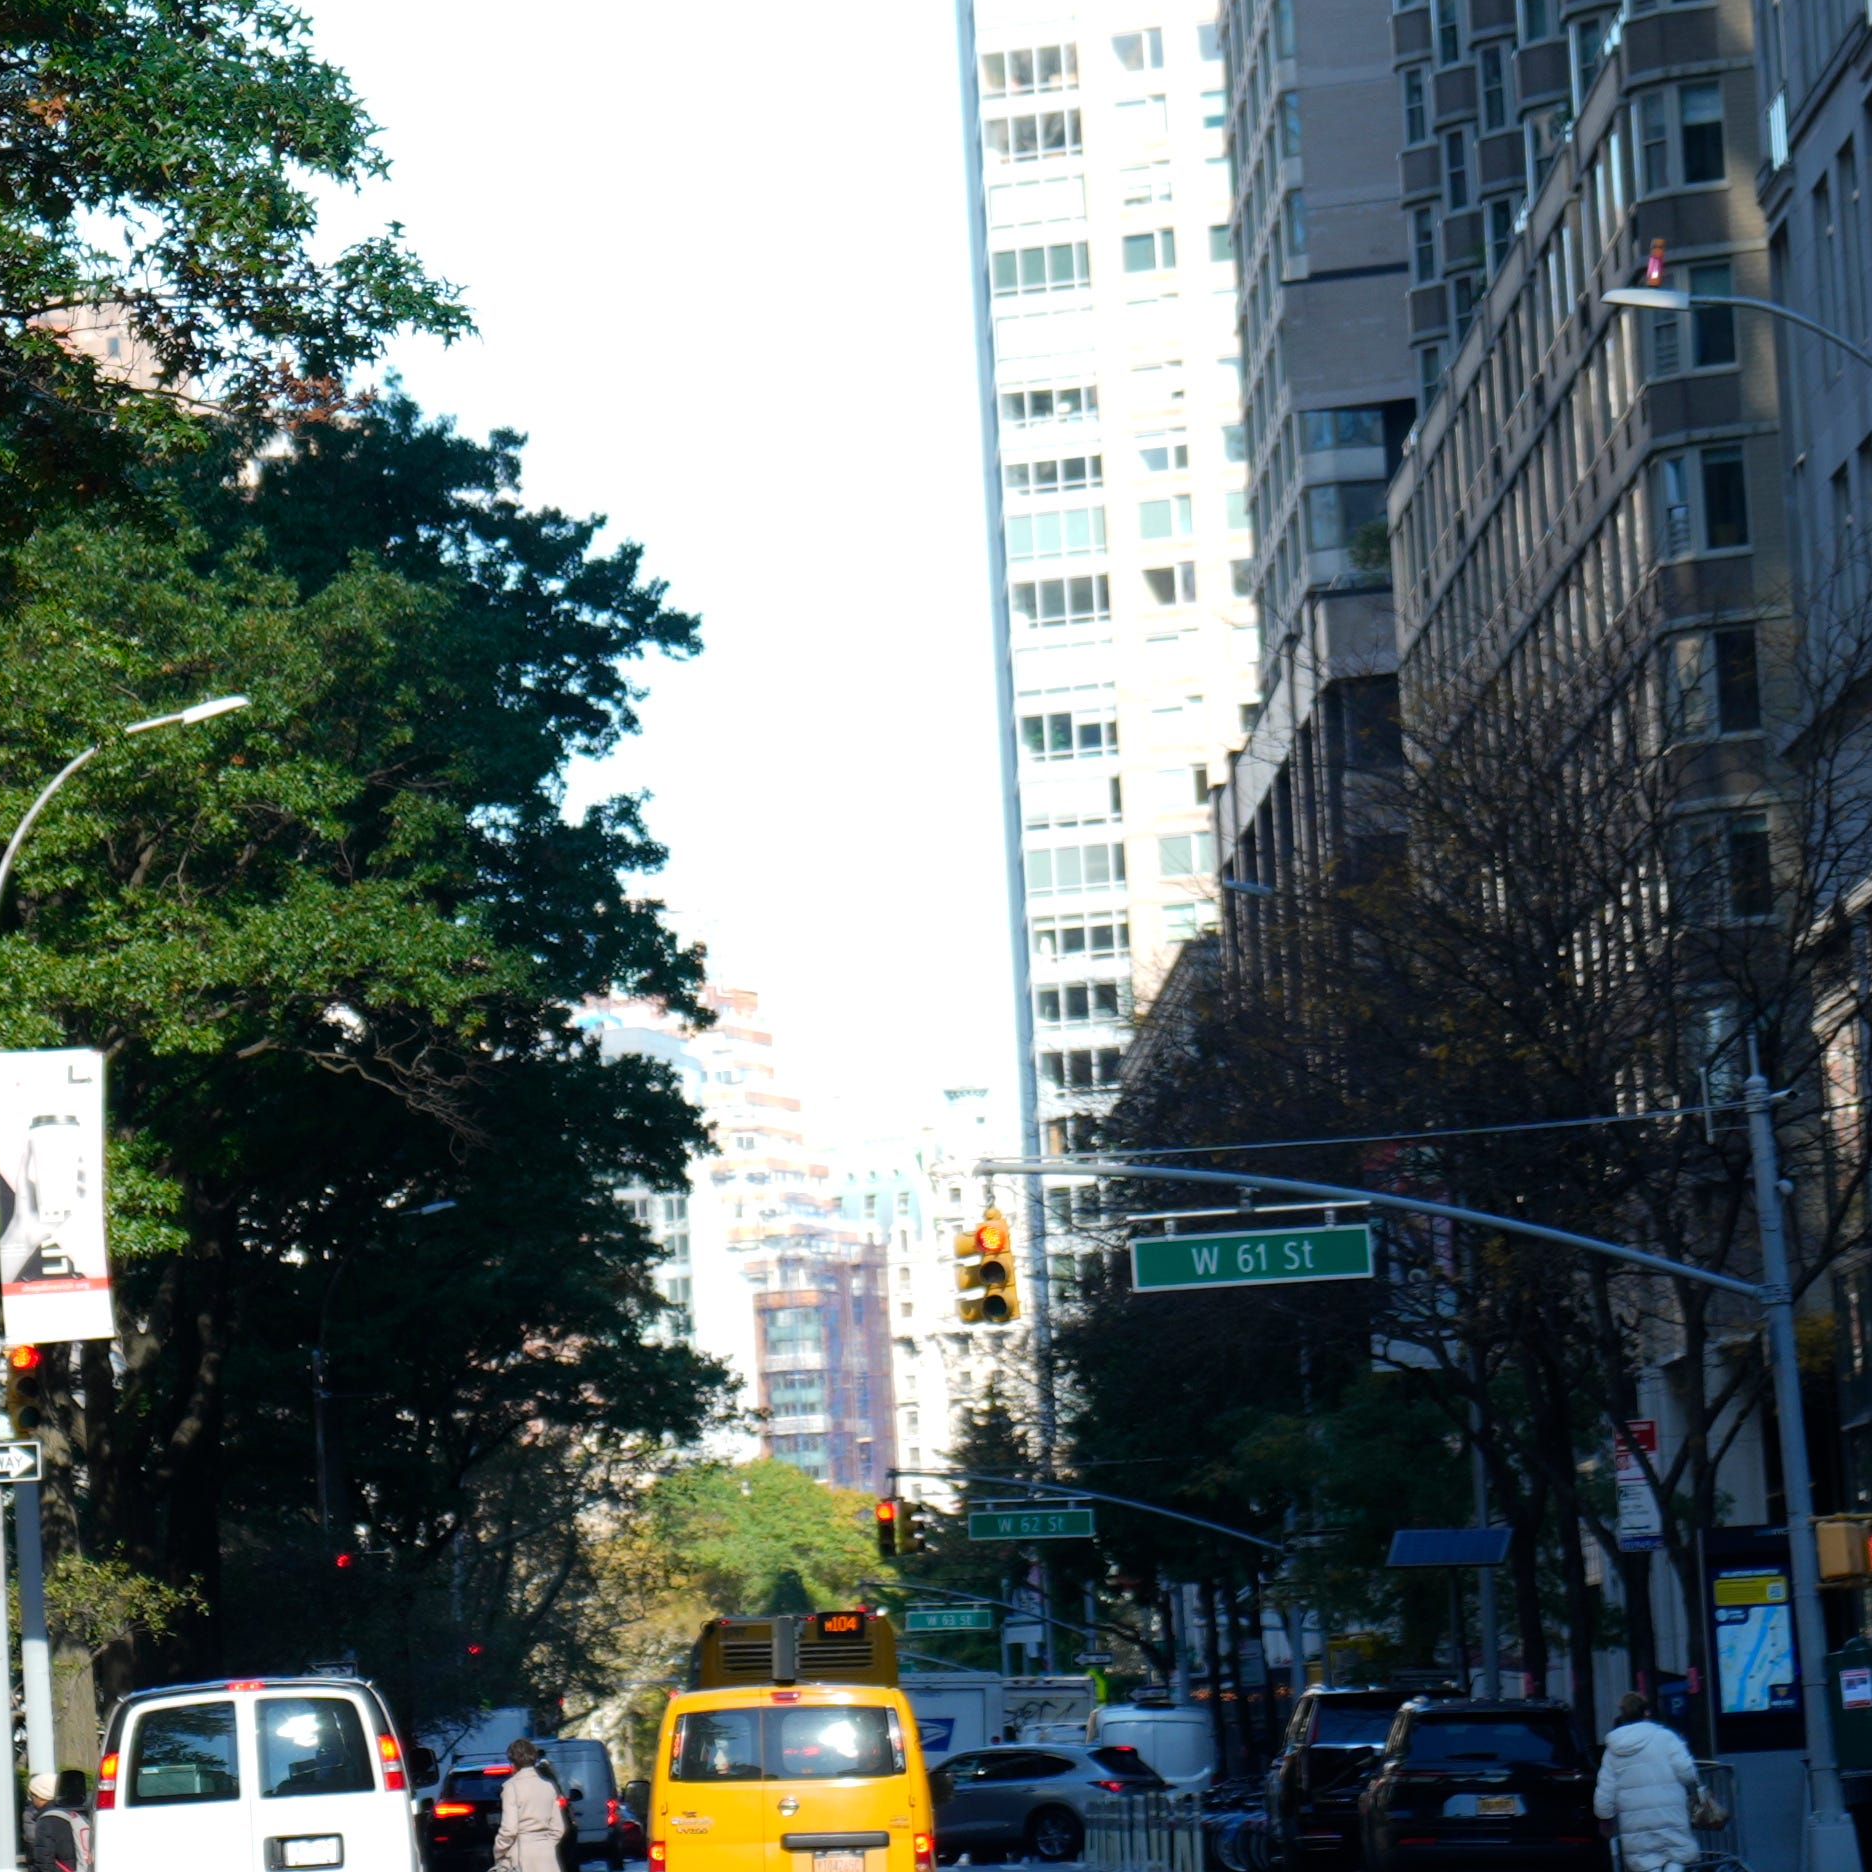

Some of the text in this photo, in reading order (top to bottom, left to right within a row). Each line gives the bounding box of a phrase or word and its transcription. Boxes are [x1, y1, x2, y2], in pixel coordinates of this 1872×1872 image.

[1191, 1240, 1314, 1275] W 61 St
[997, 1516, 1065, 1533] W 62 St
[926, 1615, 937, 1626] W
